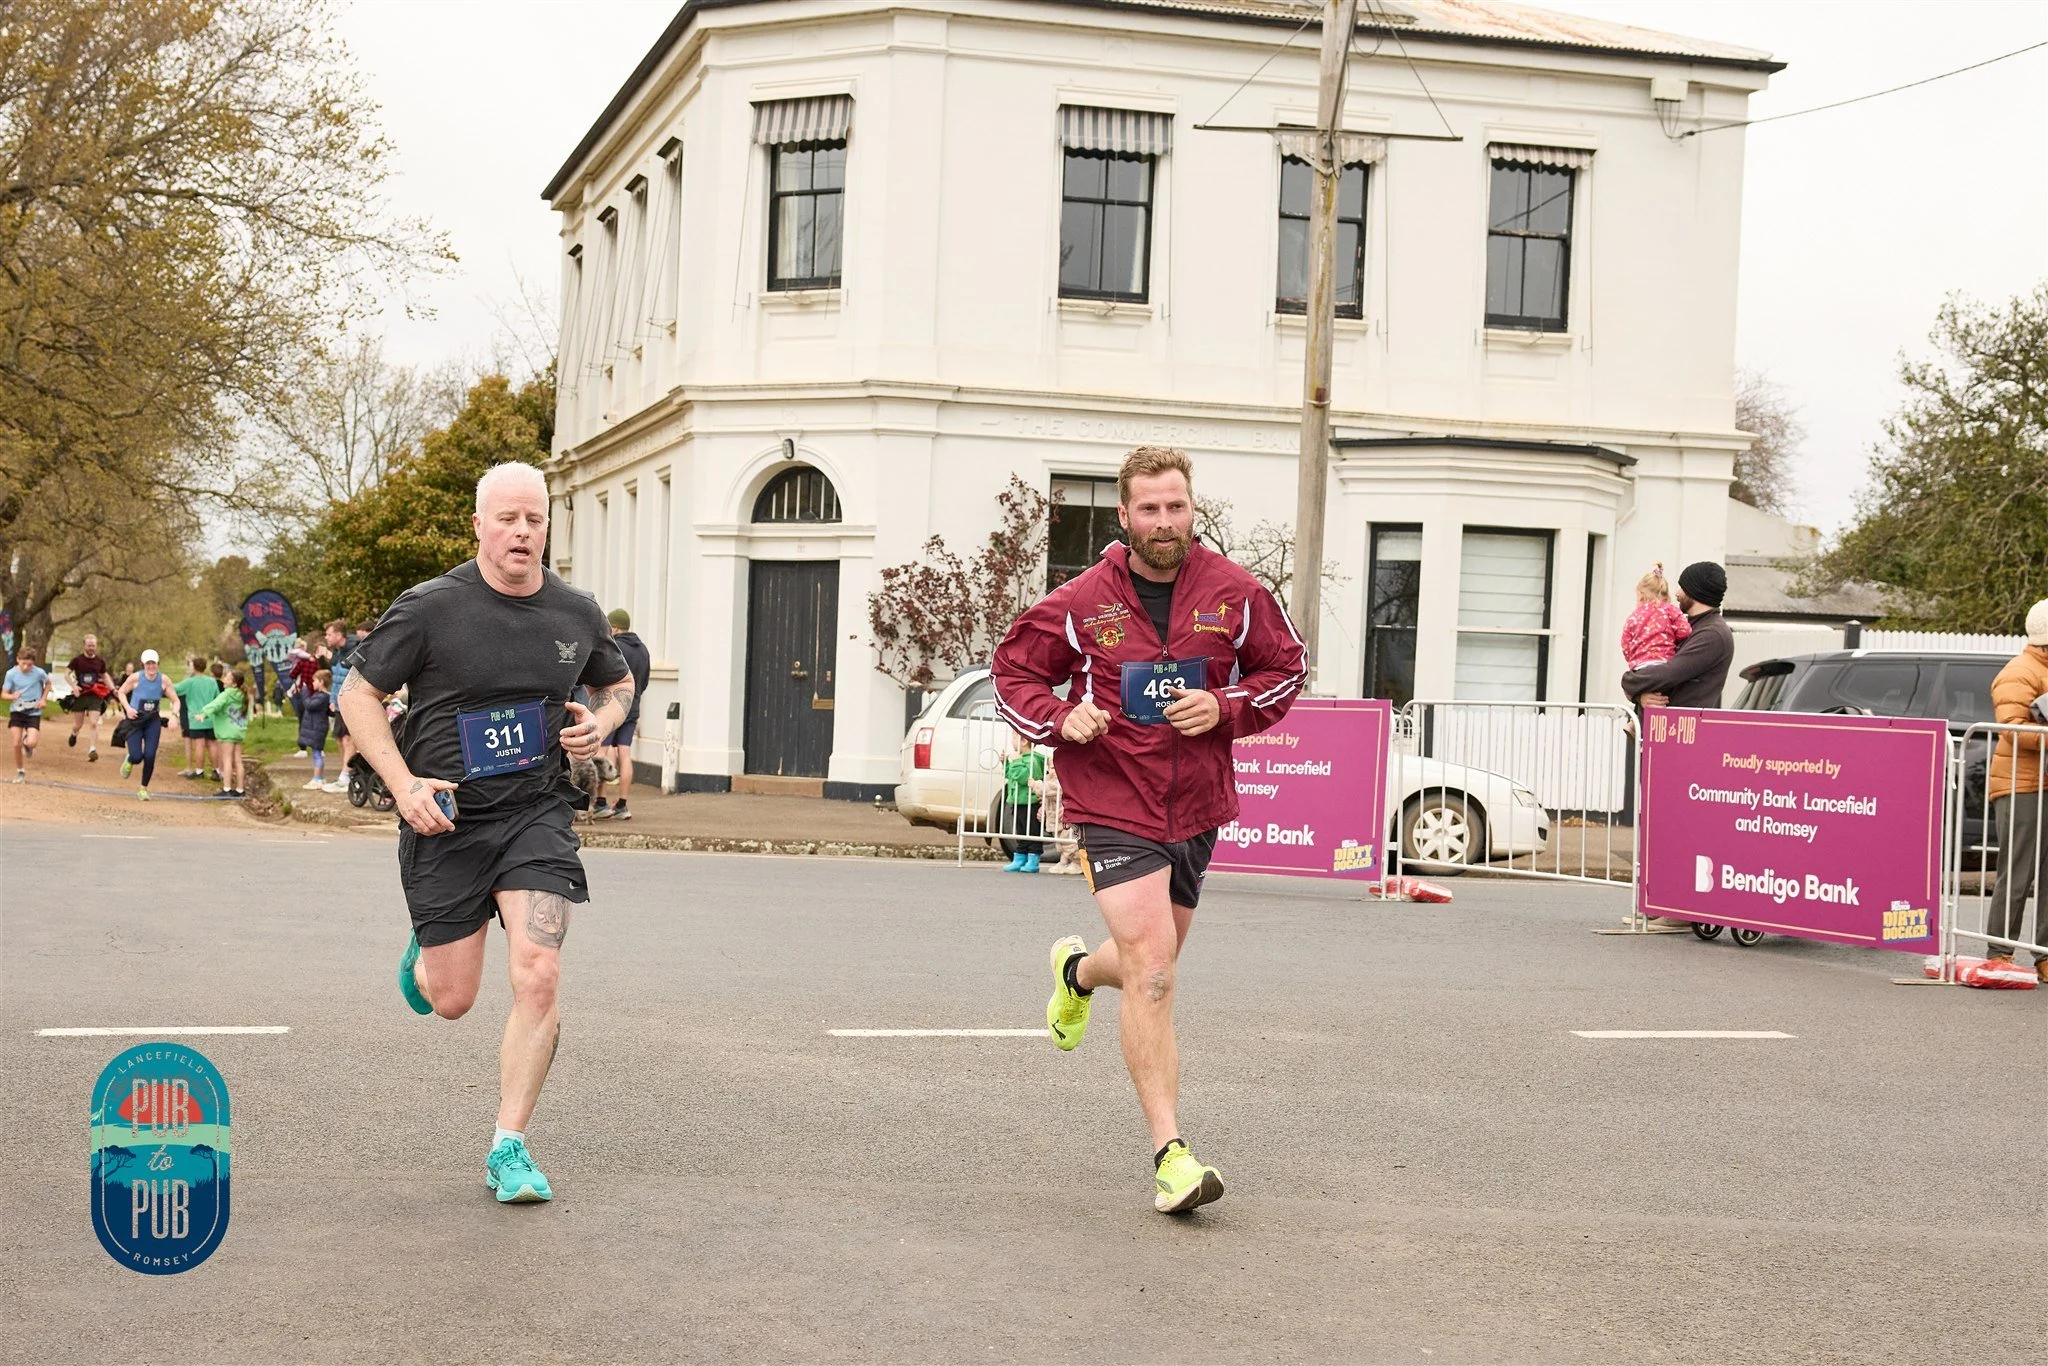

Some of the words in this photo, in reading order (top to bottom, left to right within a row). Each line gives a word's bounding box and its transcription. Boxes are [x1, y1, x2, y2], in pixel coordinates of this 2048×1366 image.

[1014, 416, 1064, 437] THE
[1077, 420, 1239, 447] COMMERCIAL
[1143, 677, 1186, 699] 463
[484, 722, 525, 749] 311
[1233, 734, 1284, 747] upported
[1285, 733, 1300, 749] by
[1650, 715, 1667, 743] PUB
[1677, 716, 1696, 745] PUB
[495, 748, 521, 758] JUSTIN
[1266, 760, 1332, 776] Lancefield
[1723, 753, 1763, 774] Proudly
[1765, 757, 1823, 776] supported
[1825, 760, 1841, 780] by
[1688, 783, 1760, 811] Community
[1763, 789, 1797, 809] Bank
[1804, 793, 1877, 817] Lancefield
[1266, 824, 1315, 846] Bank
[1735, 815, 1760, 833] and
[1763, 816, 1818, 843] Romsey
[1104, 855, 1131, 864] Bendigo
[1334, 845, 1372, 860] DIRTY
[1105, 862, 1121, 870] Bank
[1721, 864, 1800, 904] Bendigo
[1804, 874, 1860, 906] Bank
[1883, 908, 1928, 927] DIRTY
